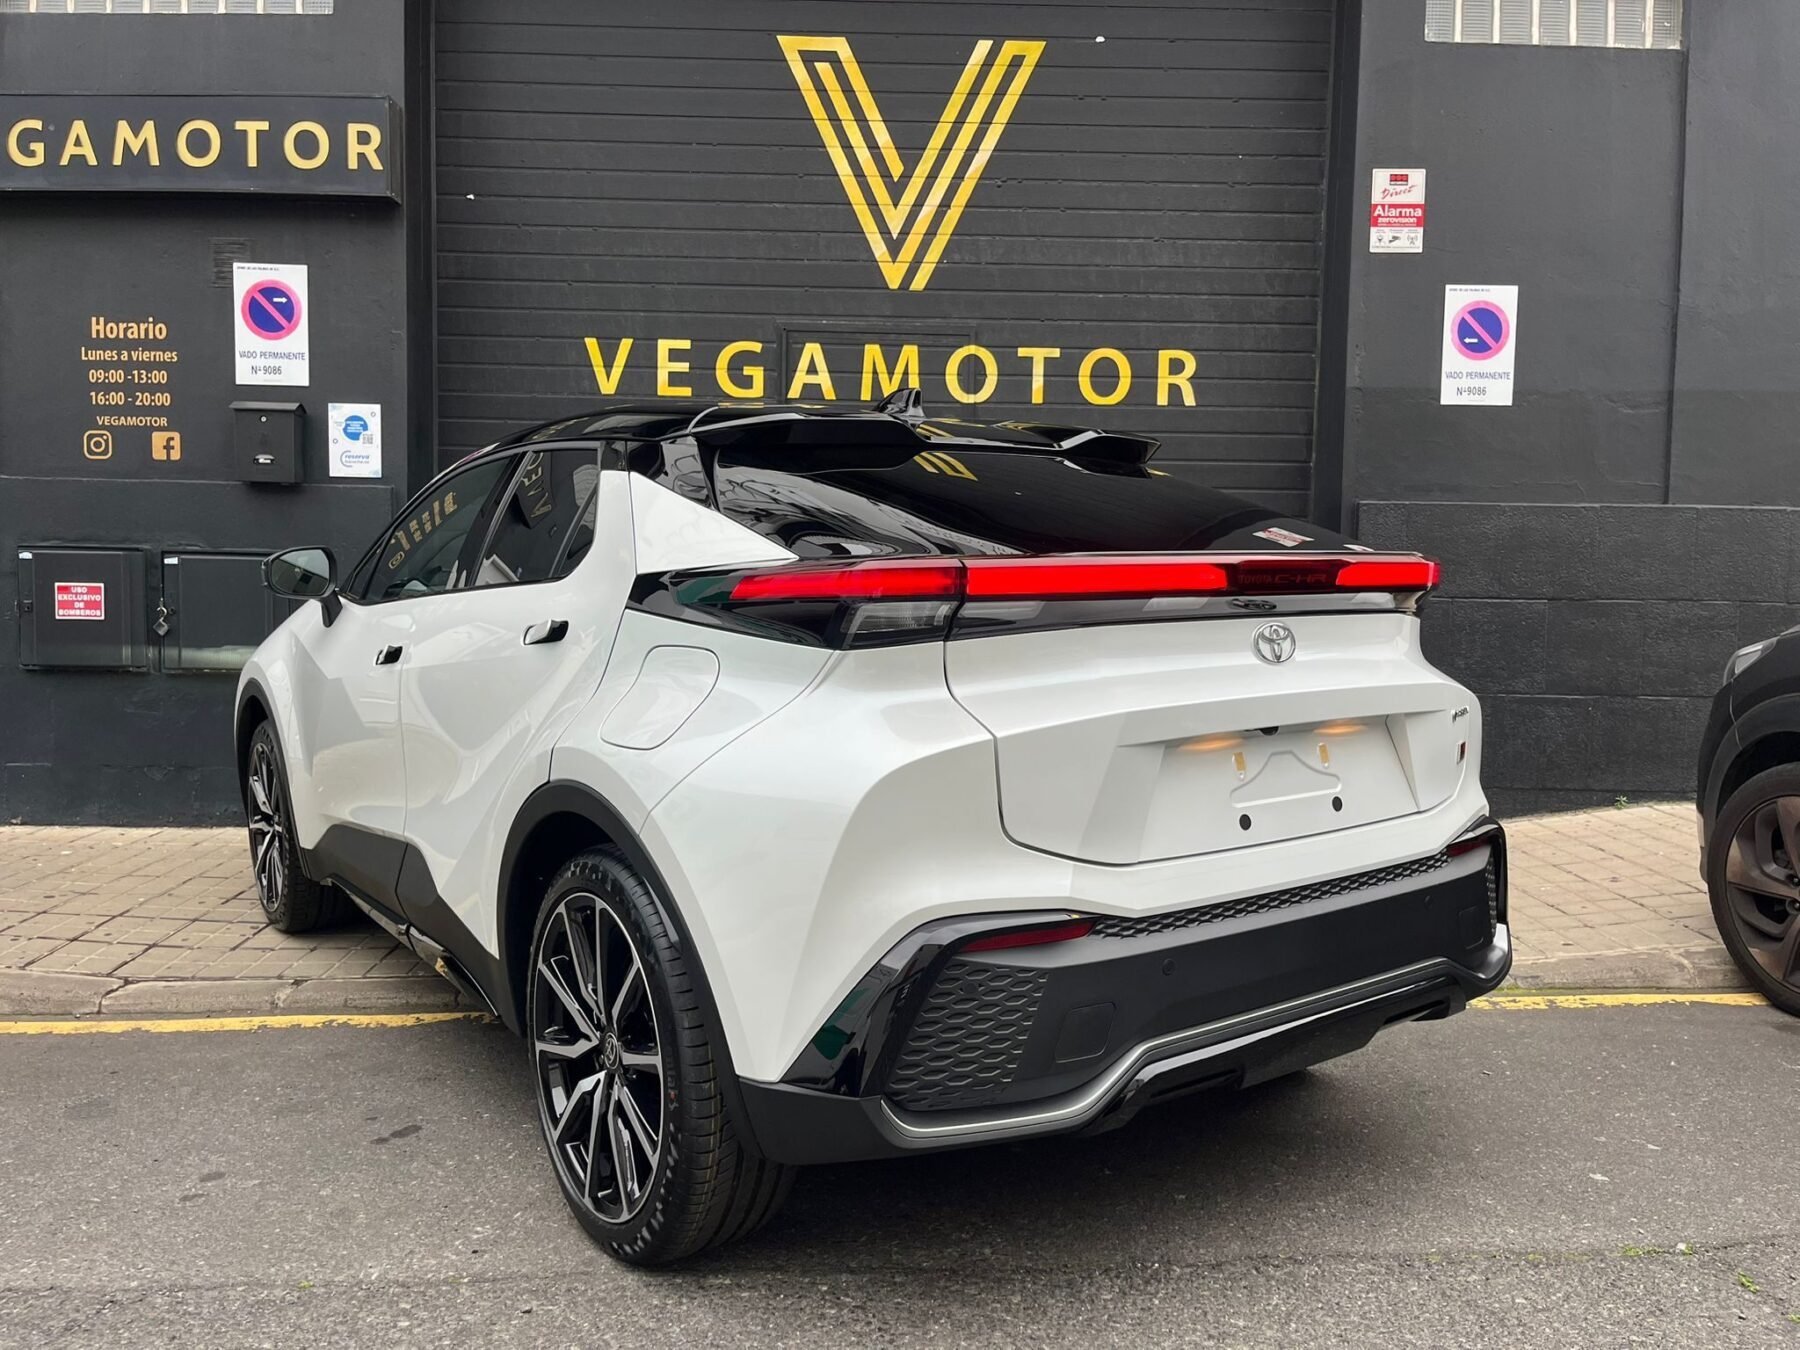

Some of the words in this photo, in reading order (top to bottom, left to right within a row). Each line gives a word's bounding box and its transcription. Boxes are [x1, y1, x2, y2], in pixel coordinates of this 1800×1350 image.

[6, 118, 385, 171] GAMOTOR
[1373, 205, 1422, 217] Alarma
[91, 316, 167, 340] Horario
[81, 346, 118, 361] Lunes
[120, 349, 128, 361] a
[131, 347, 178, 362] viernes
[238, 350, 258, 359] VADO
[259, 351, 306, 361] PERMANENTE
[88, 369, 125, 383] 09:00
[584, 337, 1198, 407] VEGAMOTOR
[1445, 370, 1464, 380] VADO
[1465, 371, 1511, 381] PERMANENTE
[89, 391, 125, 405] 16:00
[135, 392, 171, 406] 20:00
[96, 415, 168, 427] VEGAMOTOR
[74, 601, 85, 609] DE
